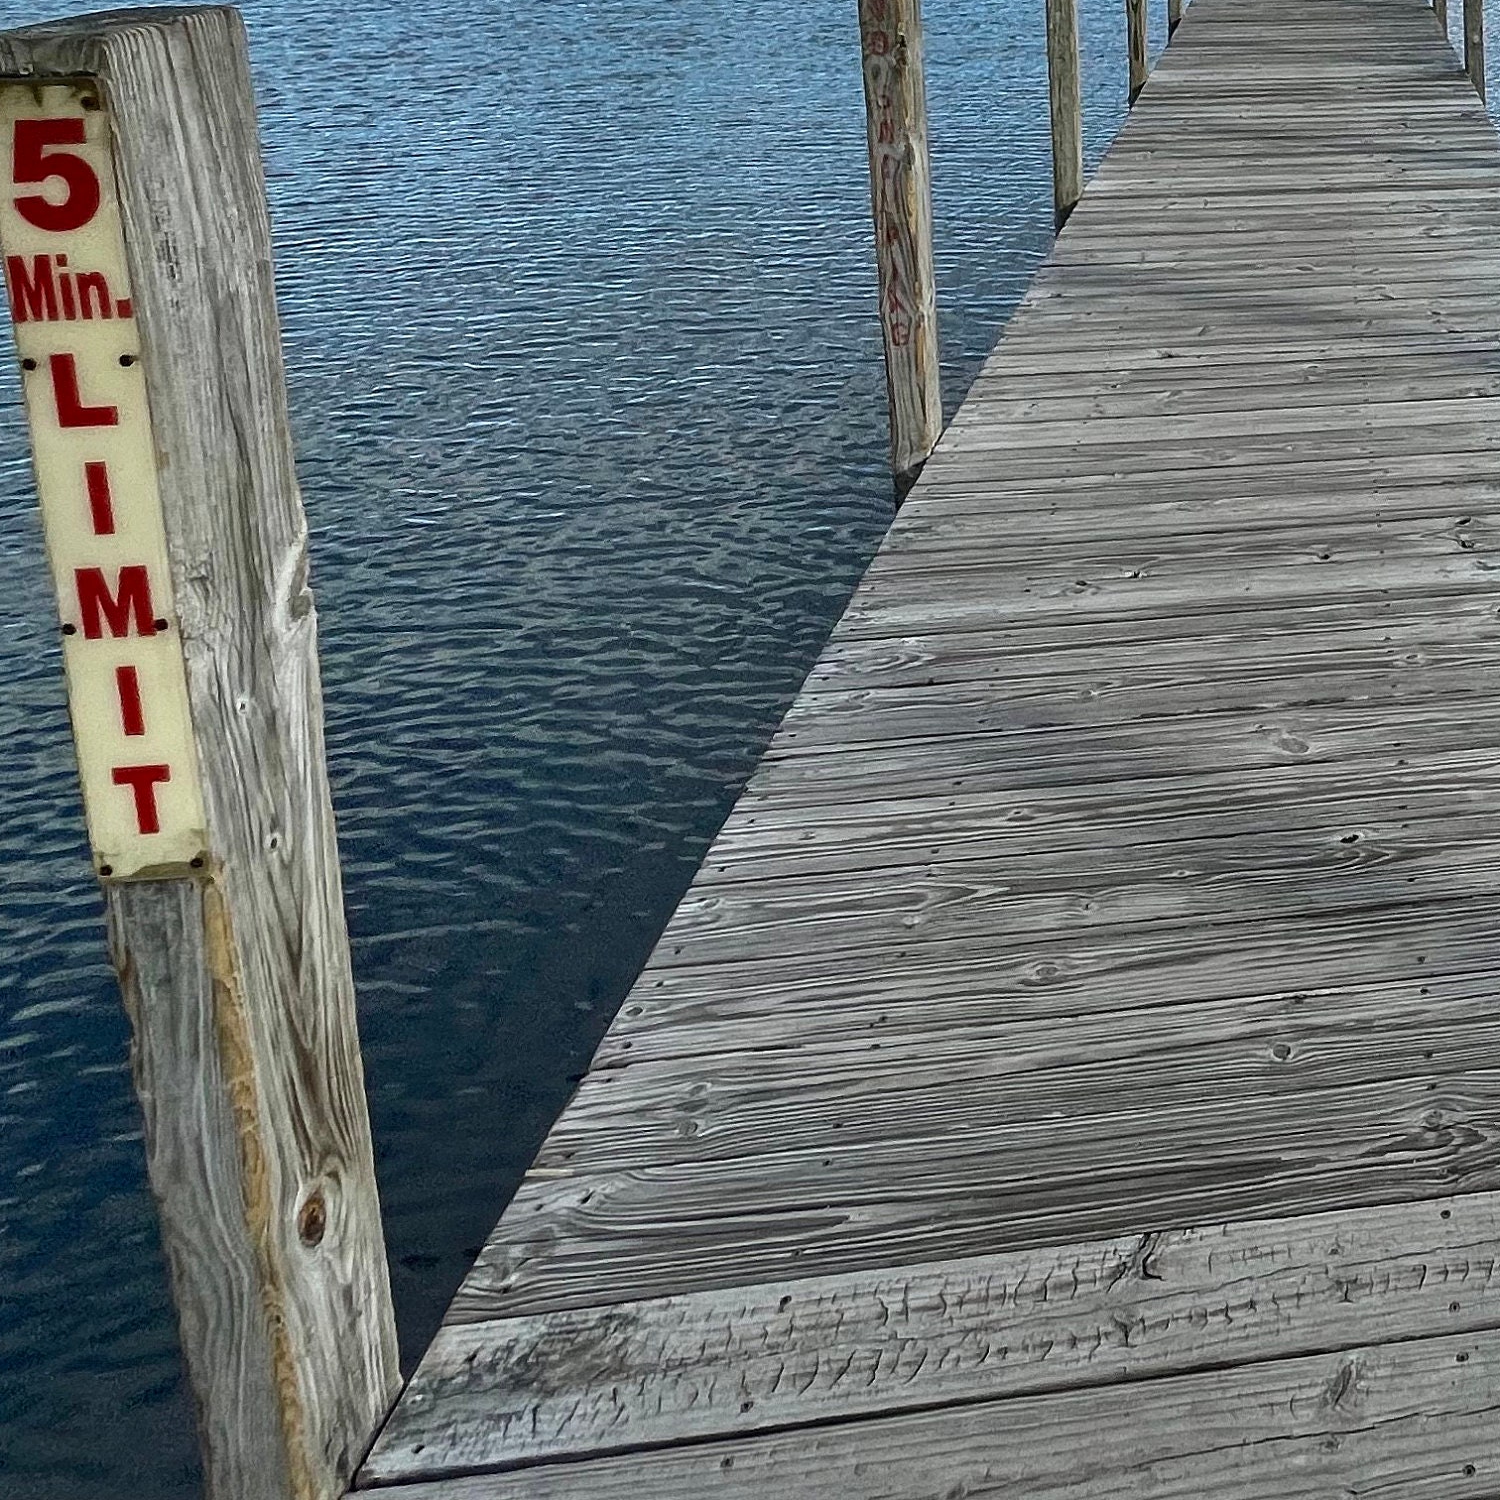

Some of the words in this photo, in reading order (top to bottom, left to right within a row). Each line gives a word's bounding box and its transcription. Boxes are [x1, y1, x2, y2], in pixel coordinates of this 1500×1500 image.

[13, 117, 101, 233] 5
[6, 252, 135, 324] Min.
[50, 351, 172, 836] LIMIT
